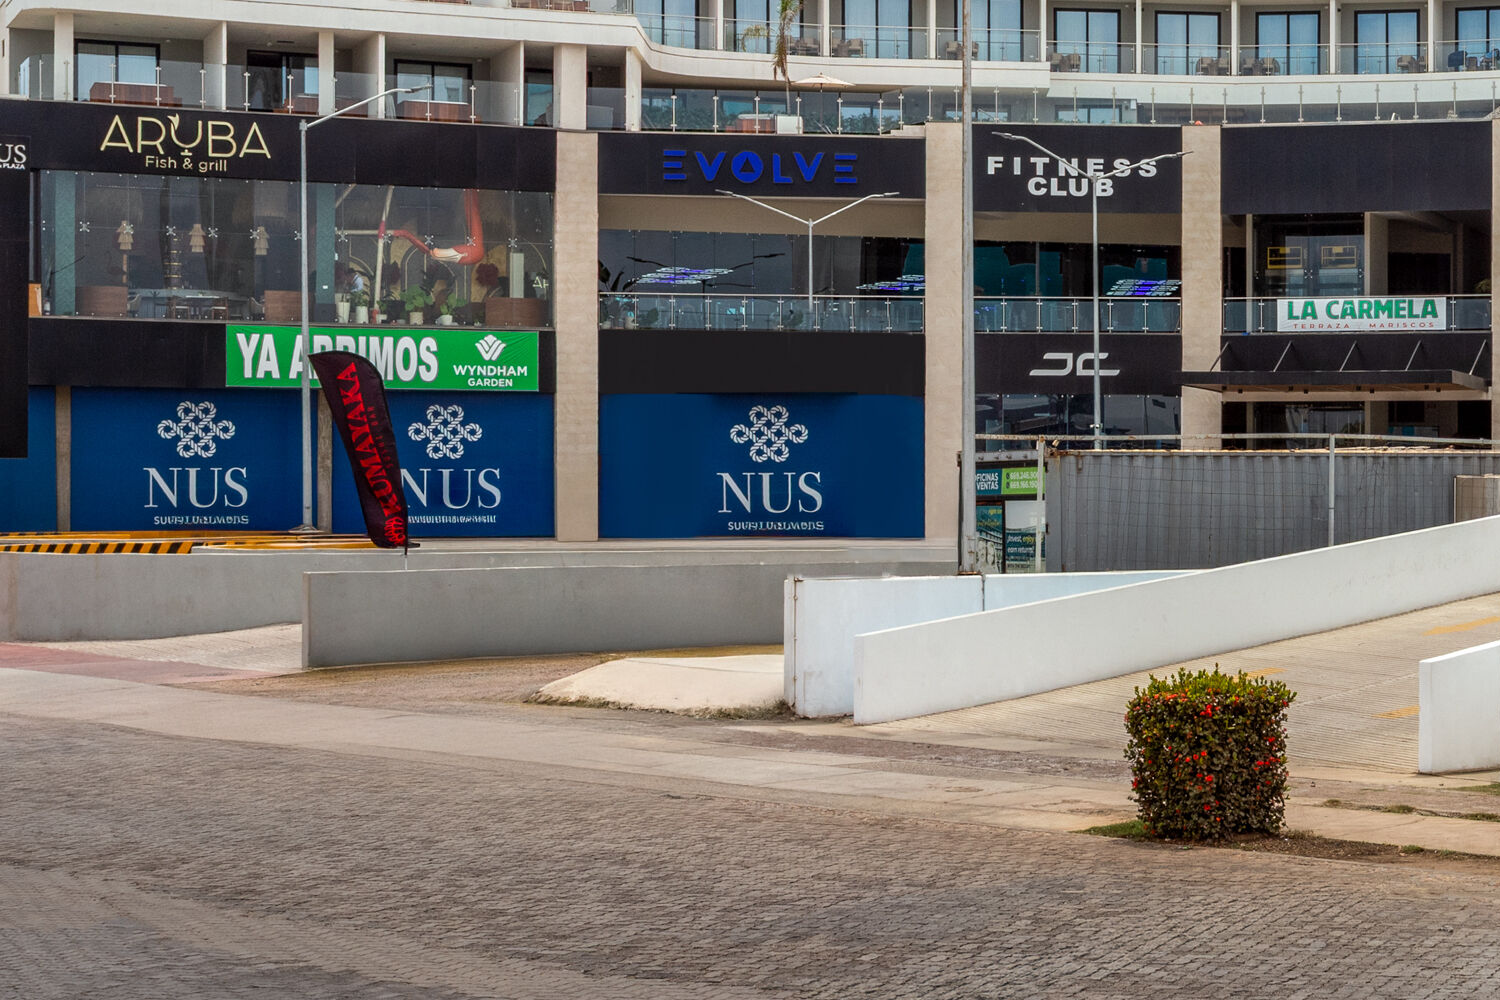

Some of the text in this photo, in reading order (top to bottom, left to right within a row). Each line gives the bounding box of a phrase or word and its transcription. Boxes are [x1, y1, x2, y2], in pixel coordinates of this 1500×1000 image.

[100, 113, 272, 159] ARUBA
[0, 143, 27, 164] US
[145, 155, 228, 173] Fish & grill
[3, 162, 26, 170] PLAZA
[663, 150, 858, 184] EVOLVE
[987, 156, 1158, 178] FITNESS
[1027, 177, 1115, 197] CLUB
[1287, 299, 1439, 320] LA CARMELA
[236, 333, 281, 379] YA
[453, 364, 528, 377] WYNDHAM
[467, 377, 513, 387] GARDEN
[337, 362, 401, 516] KUMAYAKA
[143, 467, 249, 509] NUS
[975, 472, 999, 483] FICINAS
[976, 481, 999, 491] VENTAS
[400, 468, 502, 509] NUS
[716, 471, 823, 514] NUS
